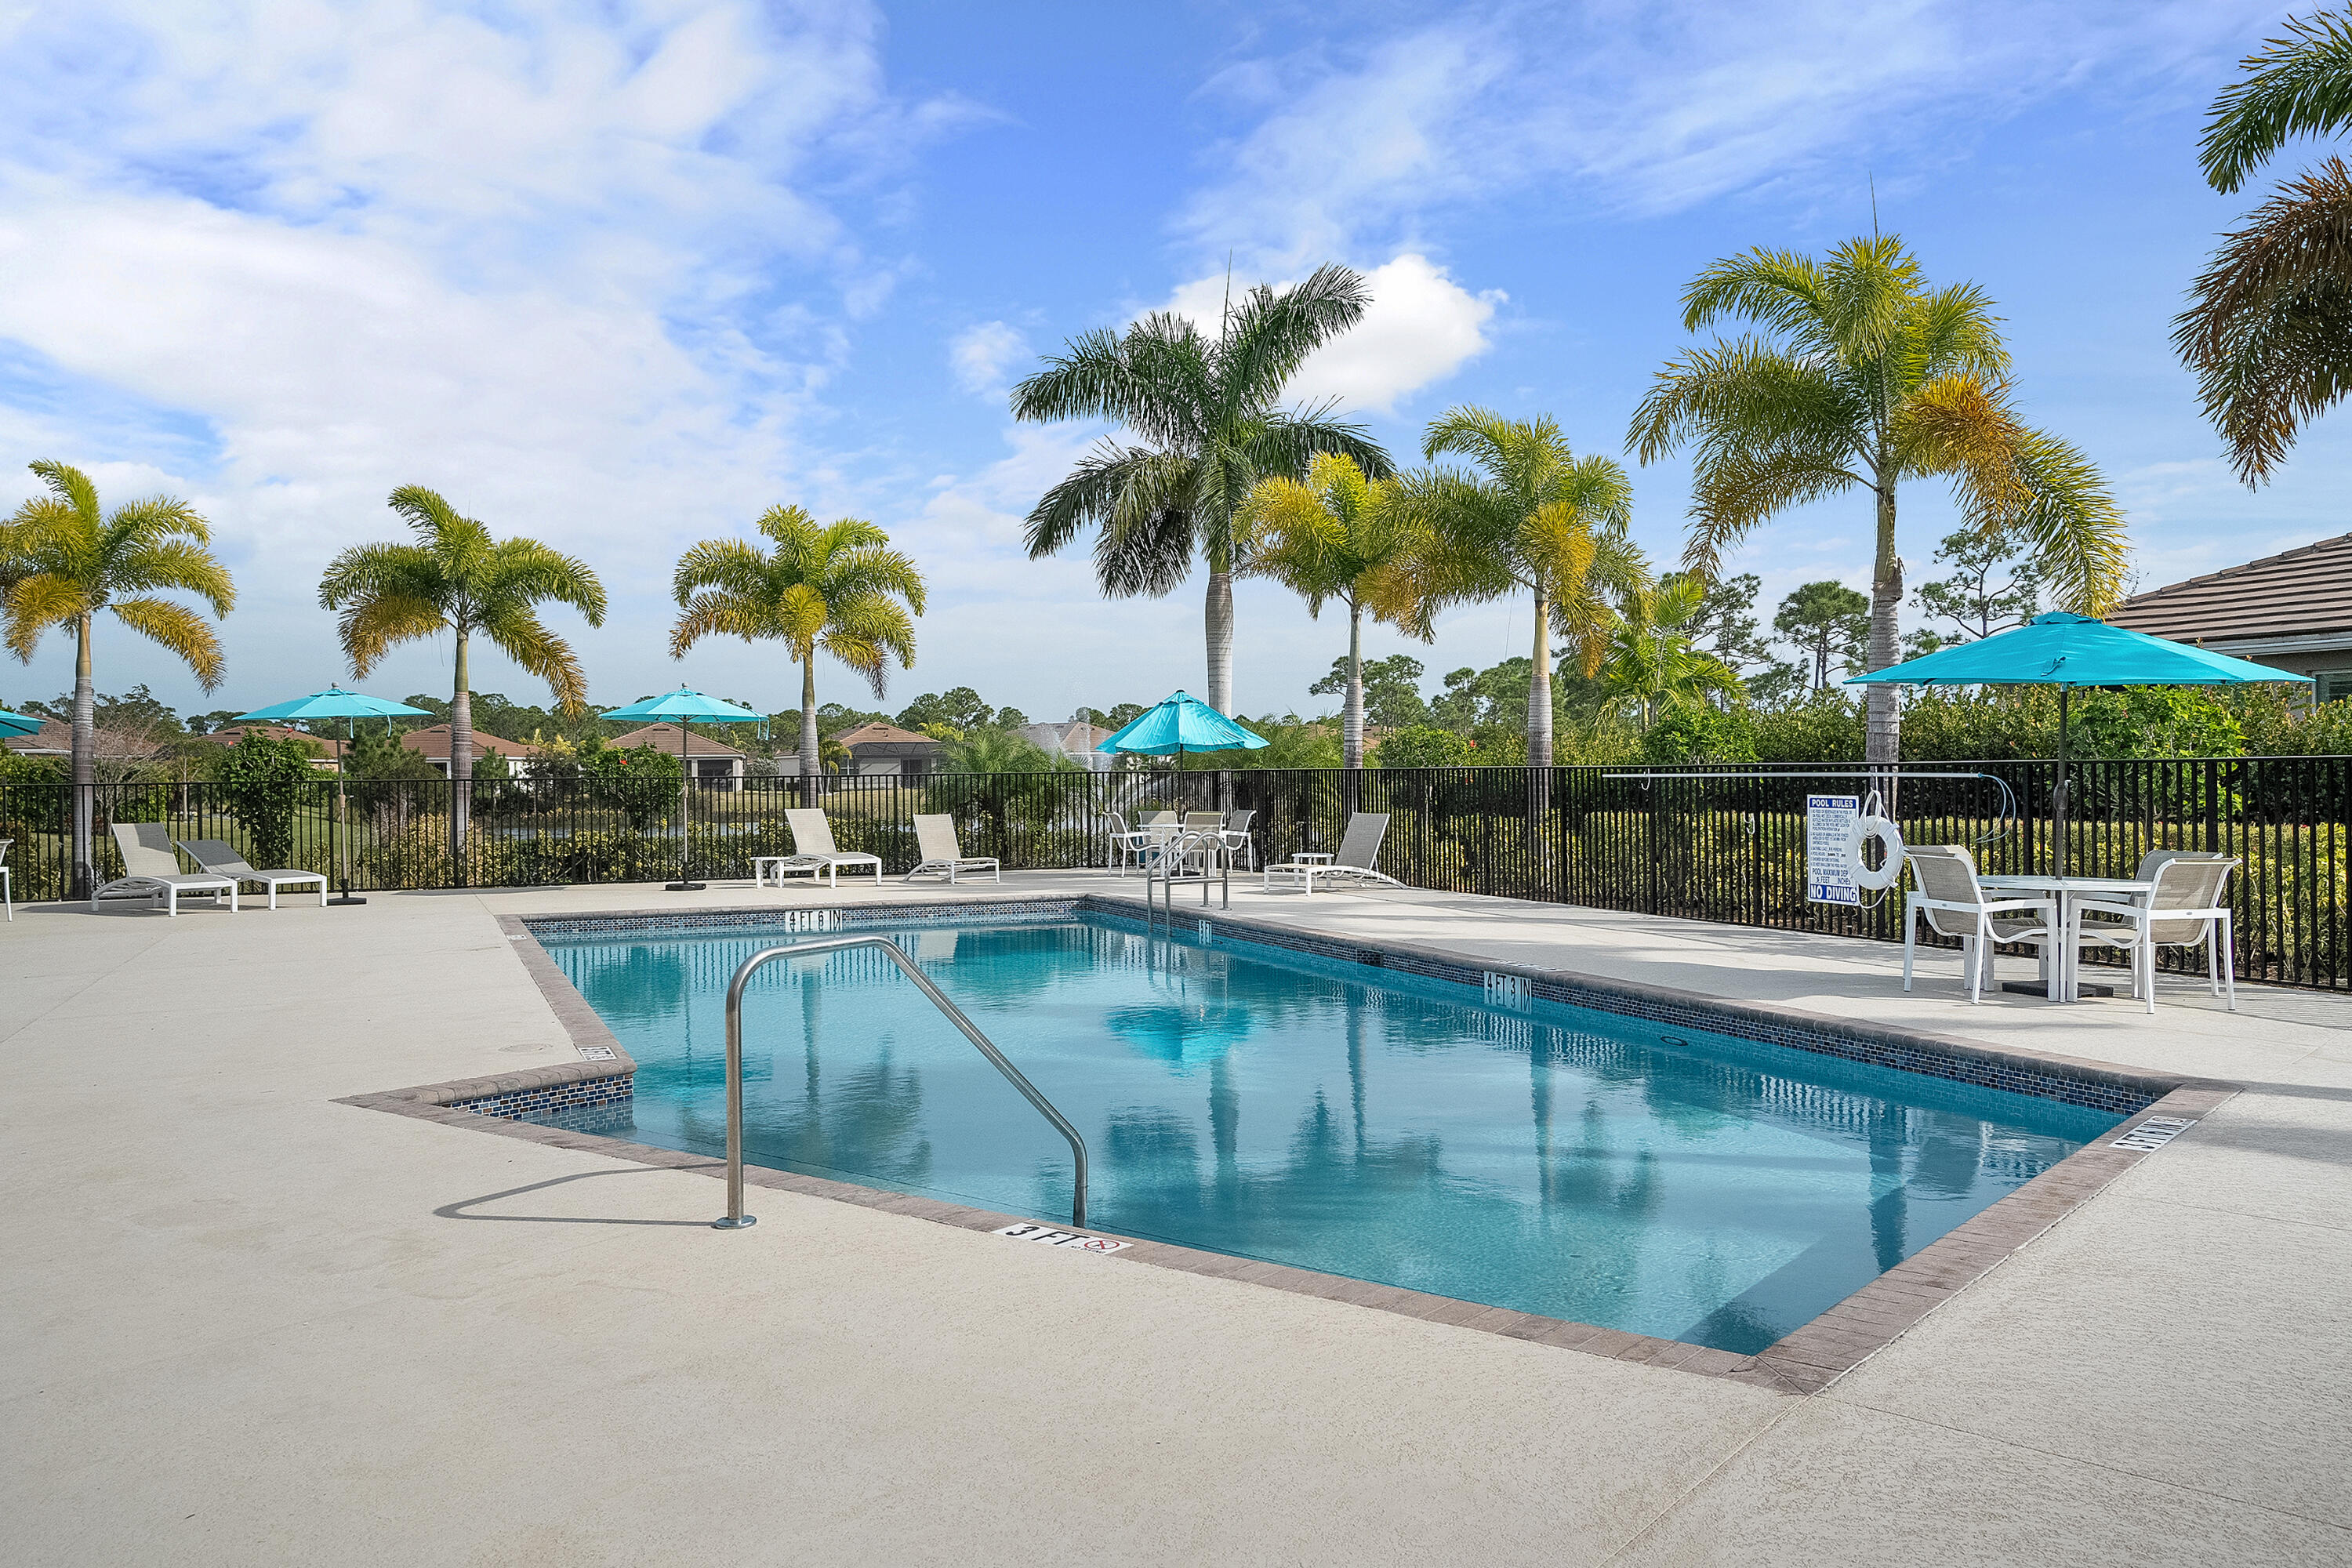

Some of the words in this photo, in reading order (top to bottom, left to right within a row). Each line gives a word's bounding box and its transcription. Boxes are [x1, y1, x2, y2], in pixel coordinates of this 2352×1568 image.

[1811, 884, 1823, 898] NO
[1826, 886, 1857, 902] DIVING
[789, 911, 796, 923] 4
[800, 910, 813, 922] FT
[829, 909, 840, 922] IN
[1487, 972, 1493, 989] 4
[1496, 974, 1506, 992] FT
[1511, 977, 1516, 994] 3
[1520, 978, 1530, 996] IN
[2122, 1134, 2167, 1145] FT
[1006, 1225, 1040, 1236] 3
[1031, 1231, 1091, 1246] FT
